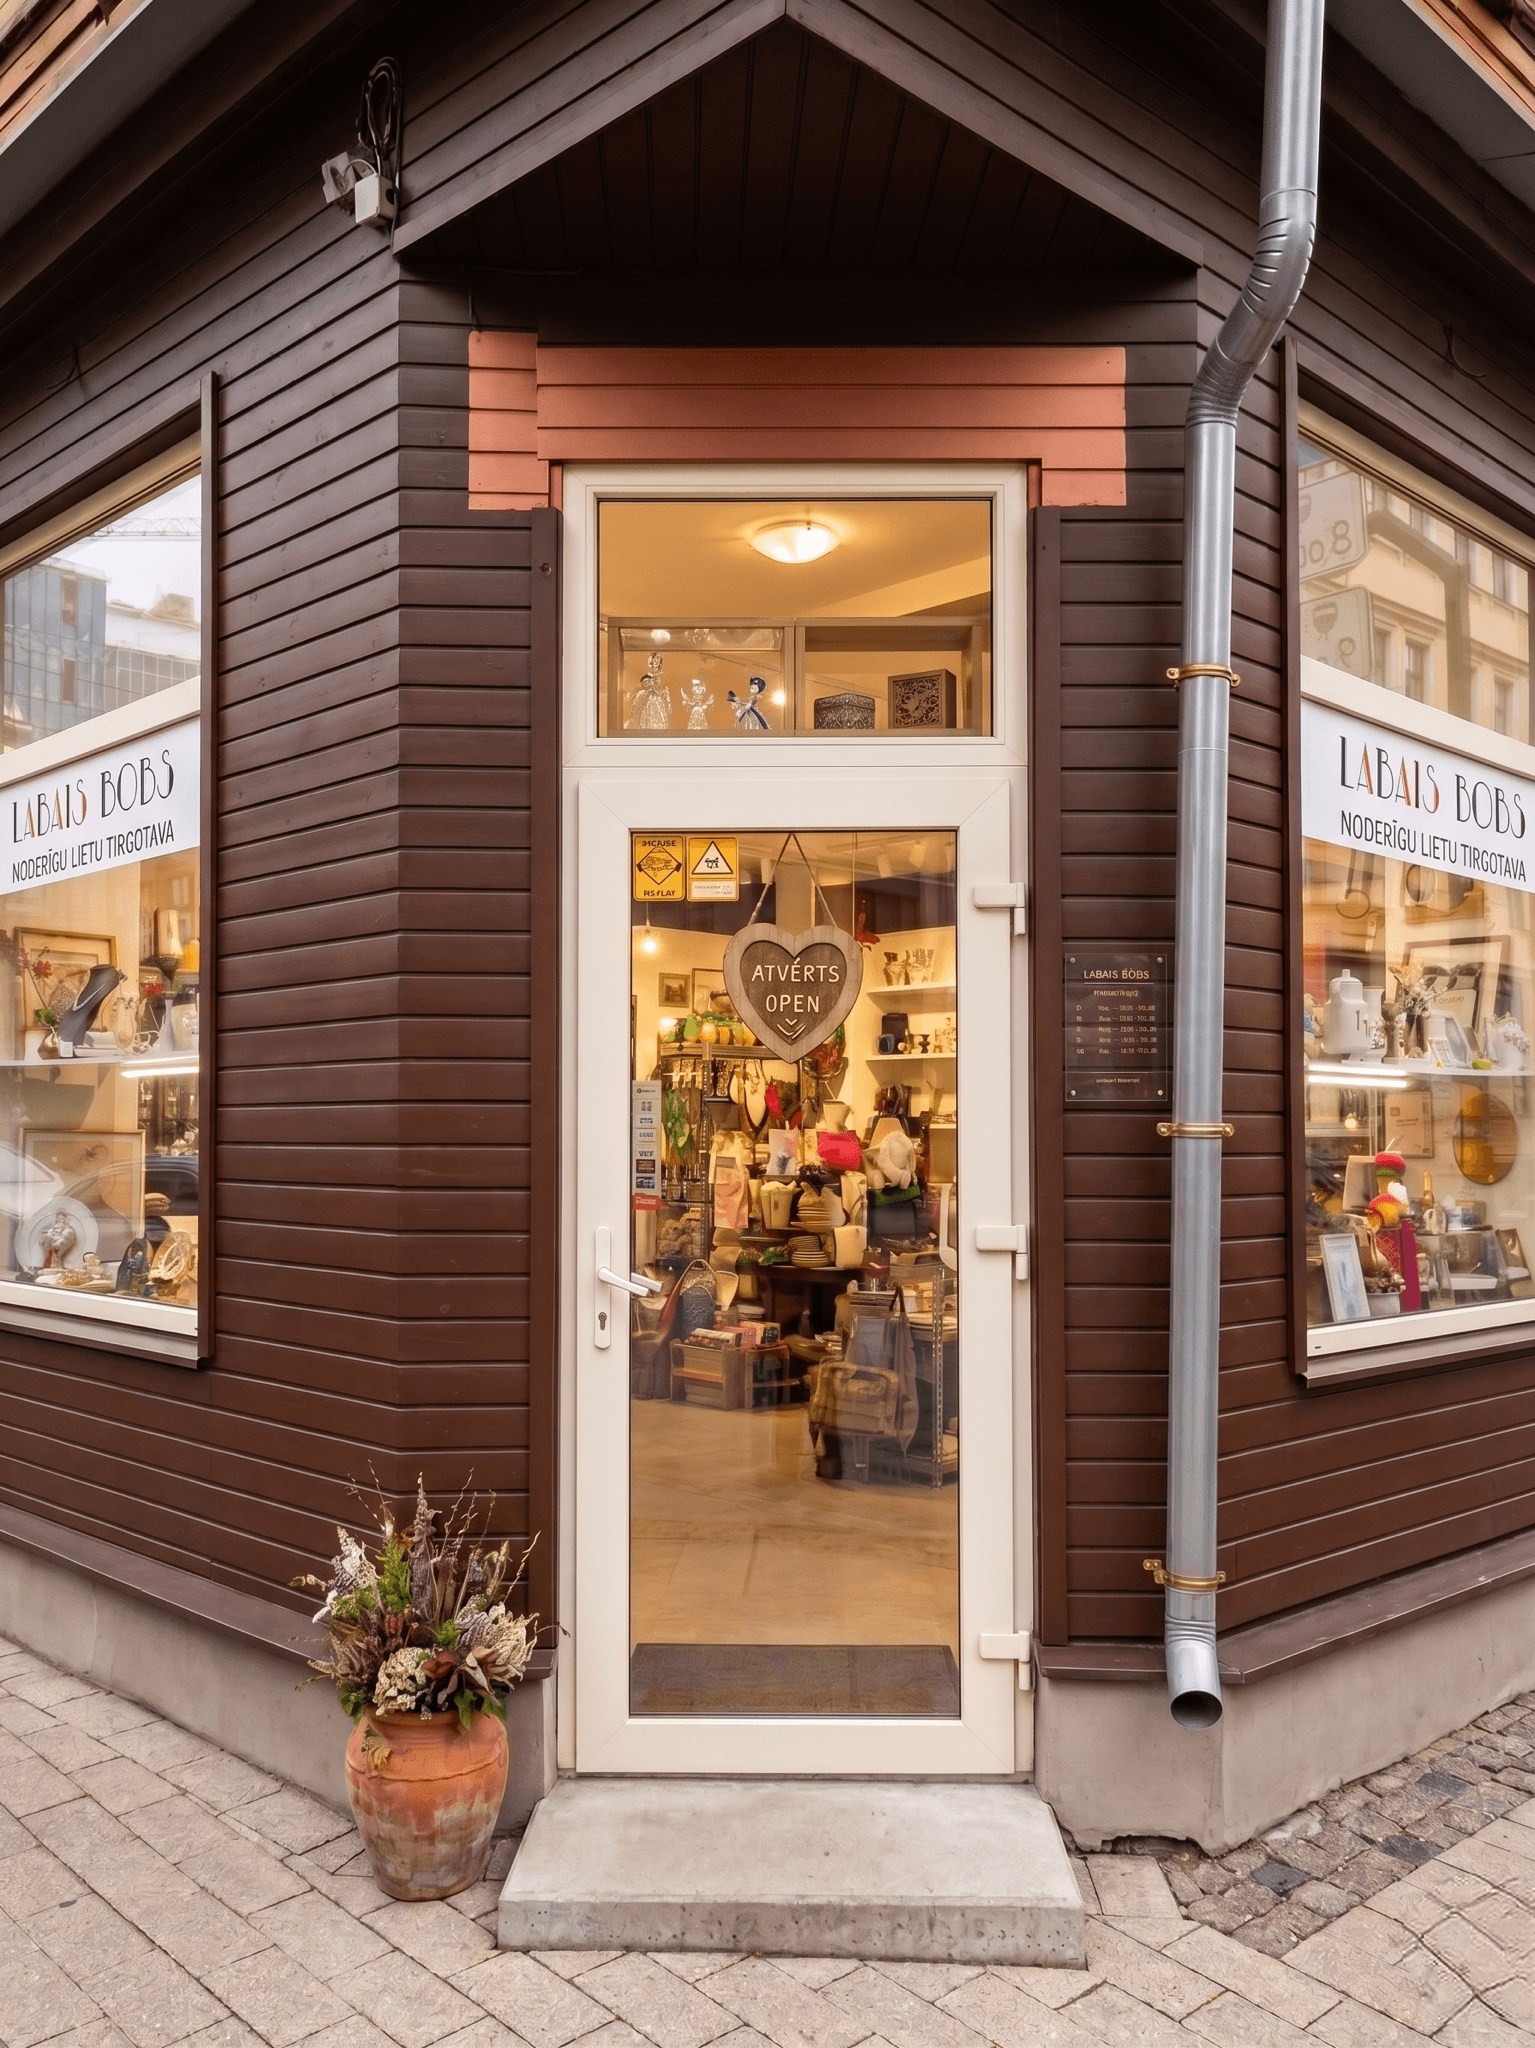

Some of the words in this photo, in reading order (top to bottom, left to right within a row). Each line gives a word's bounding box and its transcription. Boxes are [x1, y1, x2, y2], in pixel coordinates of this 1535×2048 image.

[13, 779, 88, 844] LABAIS
[100, 749, 175, 818] BOBS
[1339, 735, 1440, 814] LABAIS
[1455, 773, 1526, 839] BOBS
[12, 848, 67, 884] NODERĪGU
[71, 838, 103, 869] LIETU
[106, 819, 175, 859] TIRGOTAVA
[1341, 810, 1417, 853] NODERĪGU
[1421, 832, 1457, 864] LIETU
[1460, 843, 1527, 882] TIRGOTAVA
[765, 994, 820, 1013] OPEN
[1083, 970, 1119, 979] LABAIS
